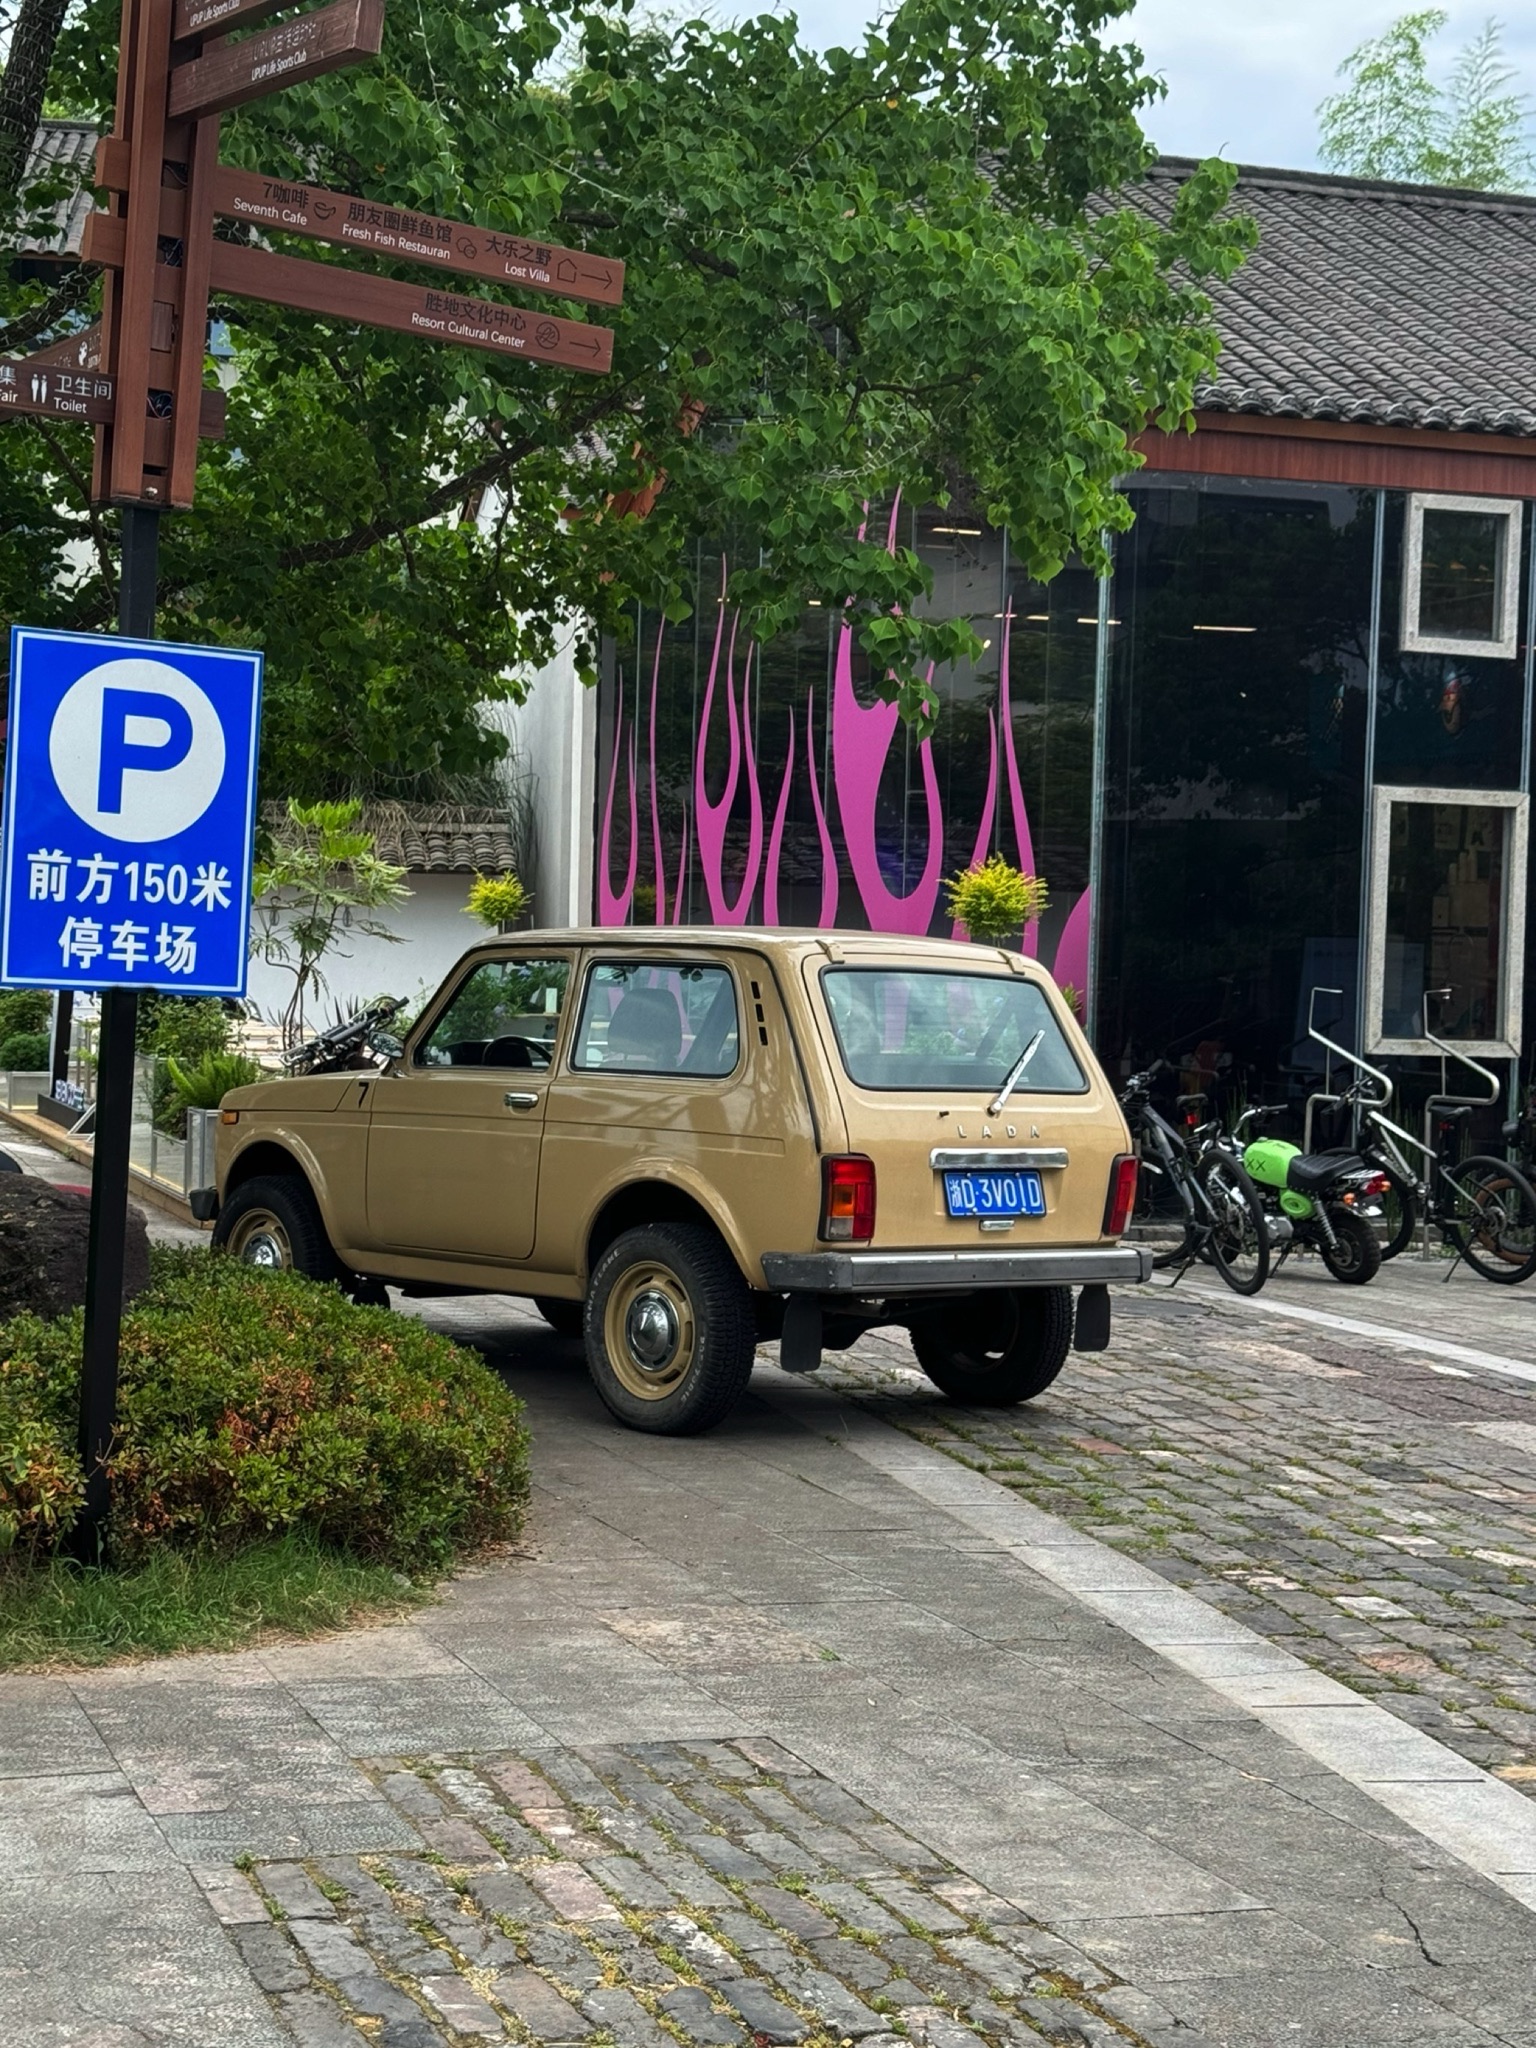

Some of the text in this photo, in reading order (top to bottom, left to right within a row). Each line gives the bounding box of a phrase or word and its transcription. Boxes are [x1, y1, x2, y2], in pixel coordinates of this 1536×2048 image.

[233, 197, 307, 226] Seventh Cafe
[262, 181, 310, 209] 7咖啡
[347, 202, 453, 243] 朋友圈鲜鱼馆
[342, 223, 451, 260] Fresh Fish Restauran
[485, 235, 553, 267] 大乐之野
[505, 262, 551, 283] Lost Villa
[425, 292, 527, 332] 胜地文化中心
[411, 312, 526, 348] Resort Cultural Center
[53, 373, 112, 400] 卫生间
[53, 397, 87, 413] Toilet
[97, 687, 194, 815] P
[27, 848, 232, 912] 前方150米
[58, 915, 198, 975] 停车场
[957, 1124, 1040, 1139] LADA
